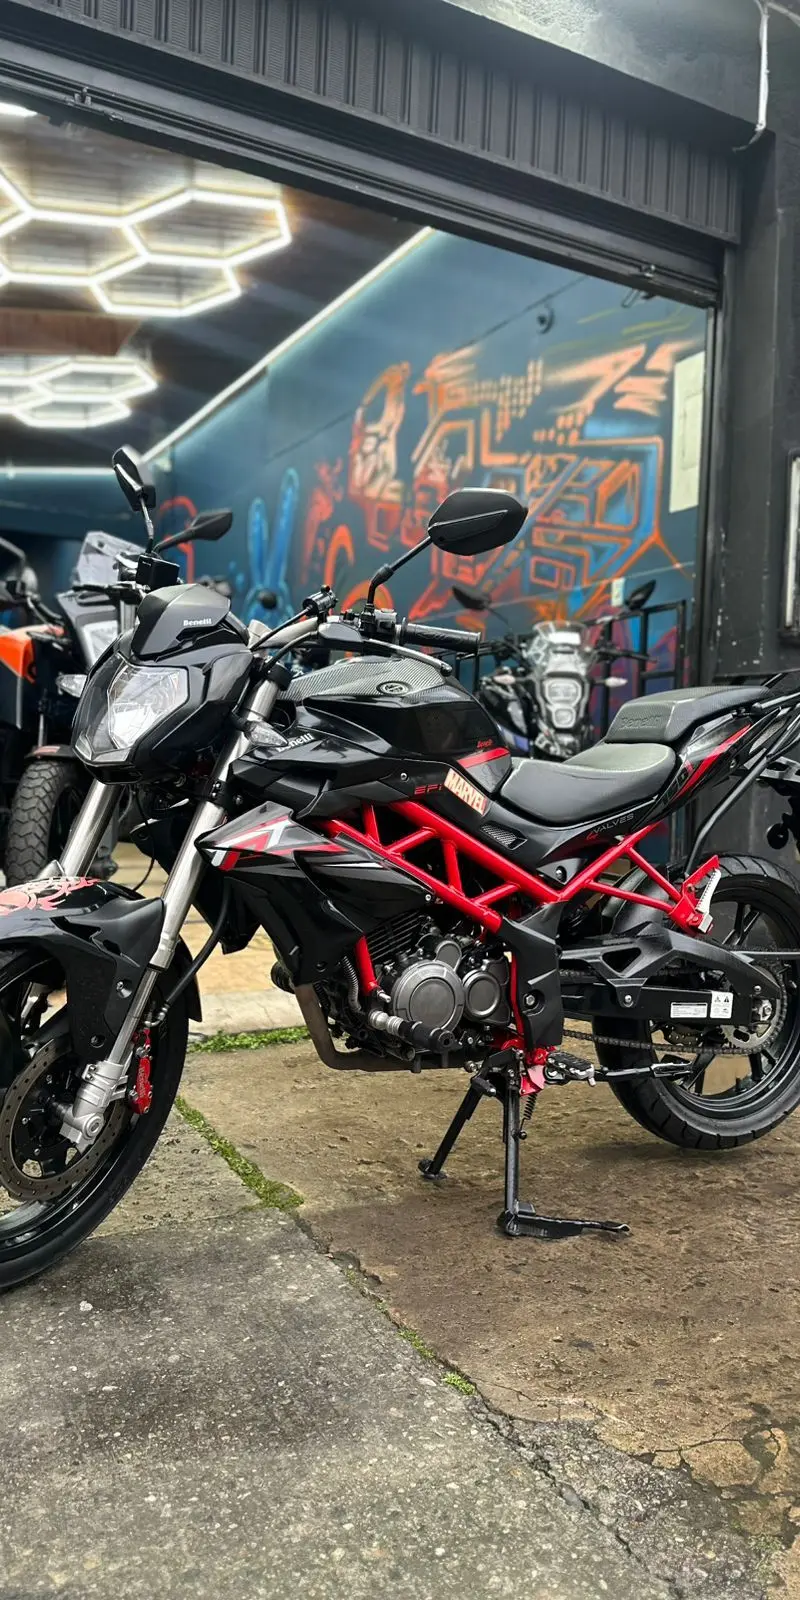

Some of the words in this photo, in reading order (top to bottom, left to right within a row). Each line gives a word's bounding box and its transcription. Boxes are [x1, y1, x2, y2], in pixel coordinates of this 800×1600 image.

[183, 618, 212, 626] Benelli
[444, 767, 487, 815] MARVEL
[593, 813, 634, 833] VALVES
